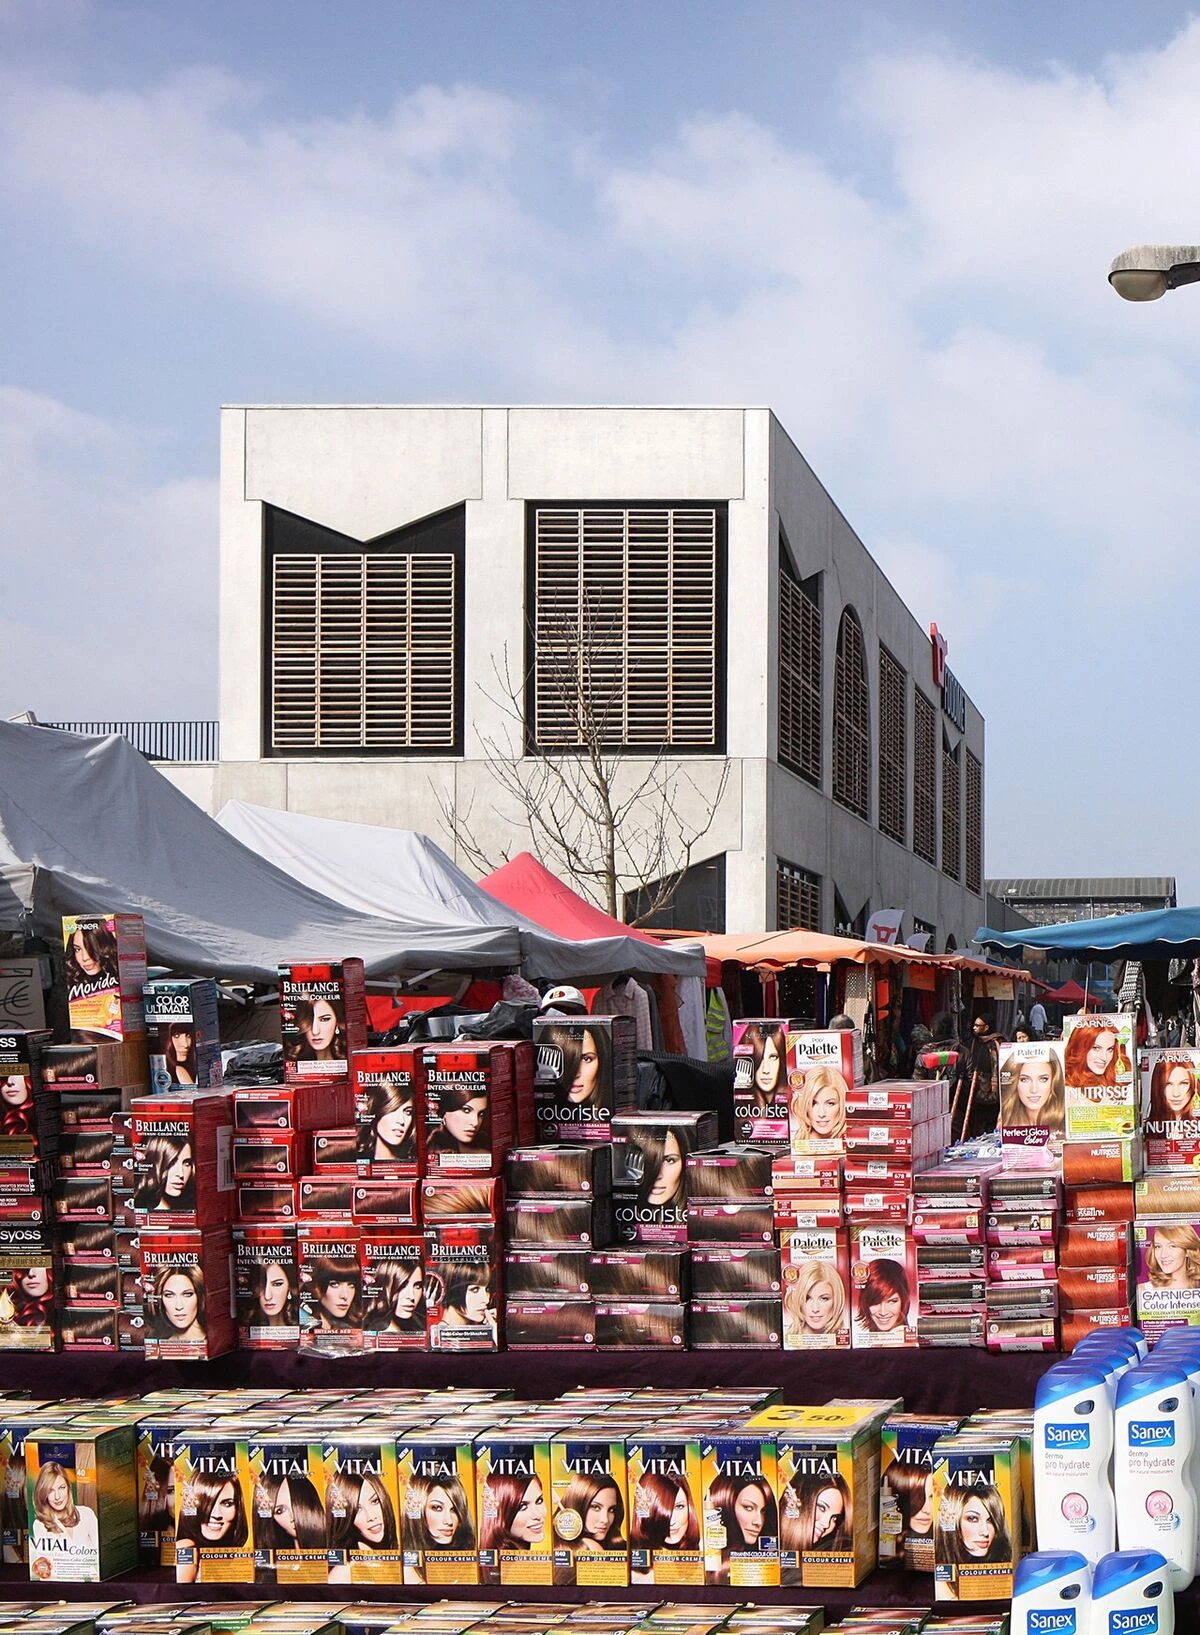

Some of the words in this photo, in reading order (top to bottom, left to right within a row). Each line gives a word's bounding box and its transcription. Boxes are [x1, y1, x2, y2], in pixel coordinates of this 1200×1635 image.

[64, 922, 99, 931] GARNIER
[68, 972, 119, 1001] Movida
[283, 981, 339, 993] BRILLANCE
[156, 995, 190, 1006] COLOR
[146, 1004, 190, 1014] ULTIMATE
[1075, 1020, 1115, 1028] GARNI
[798, 1044, 838, 1056] Palette
[1017, 1048, 1047, 1057] Palette
[357, 1070, 411, 1083] BRILLANCE
[427, 1069, 486, 1082] BRILLANCE
[1066, 1086, 1129, 1100] NUTRISSE
[537, 1104, 610, 1121] coloriste
[735, 1103, 788, 1118] coloriste
[135, 1120, 190, 1132] BRILLANCE
[1002, 1128, 1029, 1137] Perfect
[1029, 1128, 1049, 1136] Gloss
[1024, 1135, 1043, 1144] Color
[1090, 1148, 1121, 1156] NUTRISSE
[615, 1205, 688, 1222] coloriste
[0, 1230, 41, 1243] syoss
[862, 1234, 902, 1247] Palette
[1087, 1231, 1116, 1239] NUTRISSE
[301, 1242, 357, 1254] BRILLANCE
[365, 1243, 421, 1256] BRILLANCE
[431, 1243, 488, 1256] BRILLANCE
[793, 1237, 834, 1249] Palette
[237, 1244, 293, 1256] BRILLANCE
[143, 1251, 199, 1264] BRILLANCE
[1142, 1290, 1200, 1300] GARNIER
[1143, 1300, 1167, 1309] Color
[1047, 1426, 1087, 1441] Sanex
[1131, 1424, 1172, 1439] Sanex
[147, 1442, 175, 1458] VIT
[891, 1448, 933, 1465] VITA
[1128, 1450, 1149, 1458] dermo
[185, 1456, 237, 1473] VITAL
[259, 1459, 309, 1475] VITAL
[333, 1458, 384, 1475] VITAL
[407, 1460, 459, 1476] VITAL
[485, 1458, 537, 1475] VITAL
[561, 1458, 613, 1475] VITAL
[637, 1458, 688, 1475] VITAL
[712, 1460, 763, 1477] VITAL
[788, 1458, 840, 1475] VITAL
[1044, 1461, 1058, 1470] pro
[1058, 1460, 1091, 1471] hydrate
[1128, 1460, 1142, 1468] pro
[1143, 1457, 1176, 1469] hydrate
[942, 1470, 996, 1487] VITAL
[30, 1537, 69, 1552] VITAL
[68, 1545, 98, 1556] Colors
[1030, 1611, 1073, 1629] Sanex
[1112, 1611, 1155, 1628] Sanex
